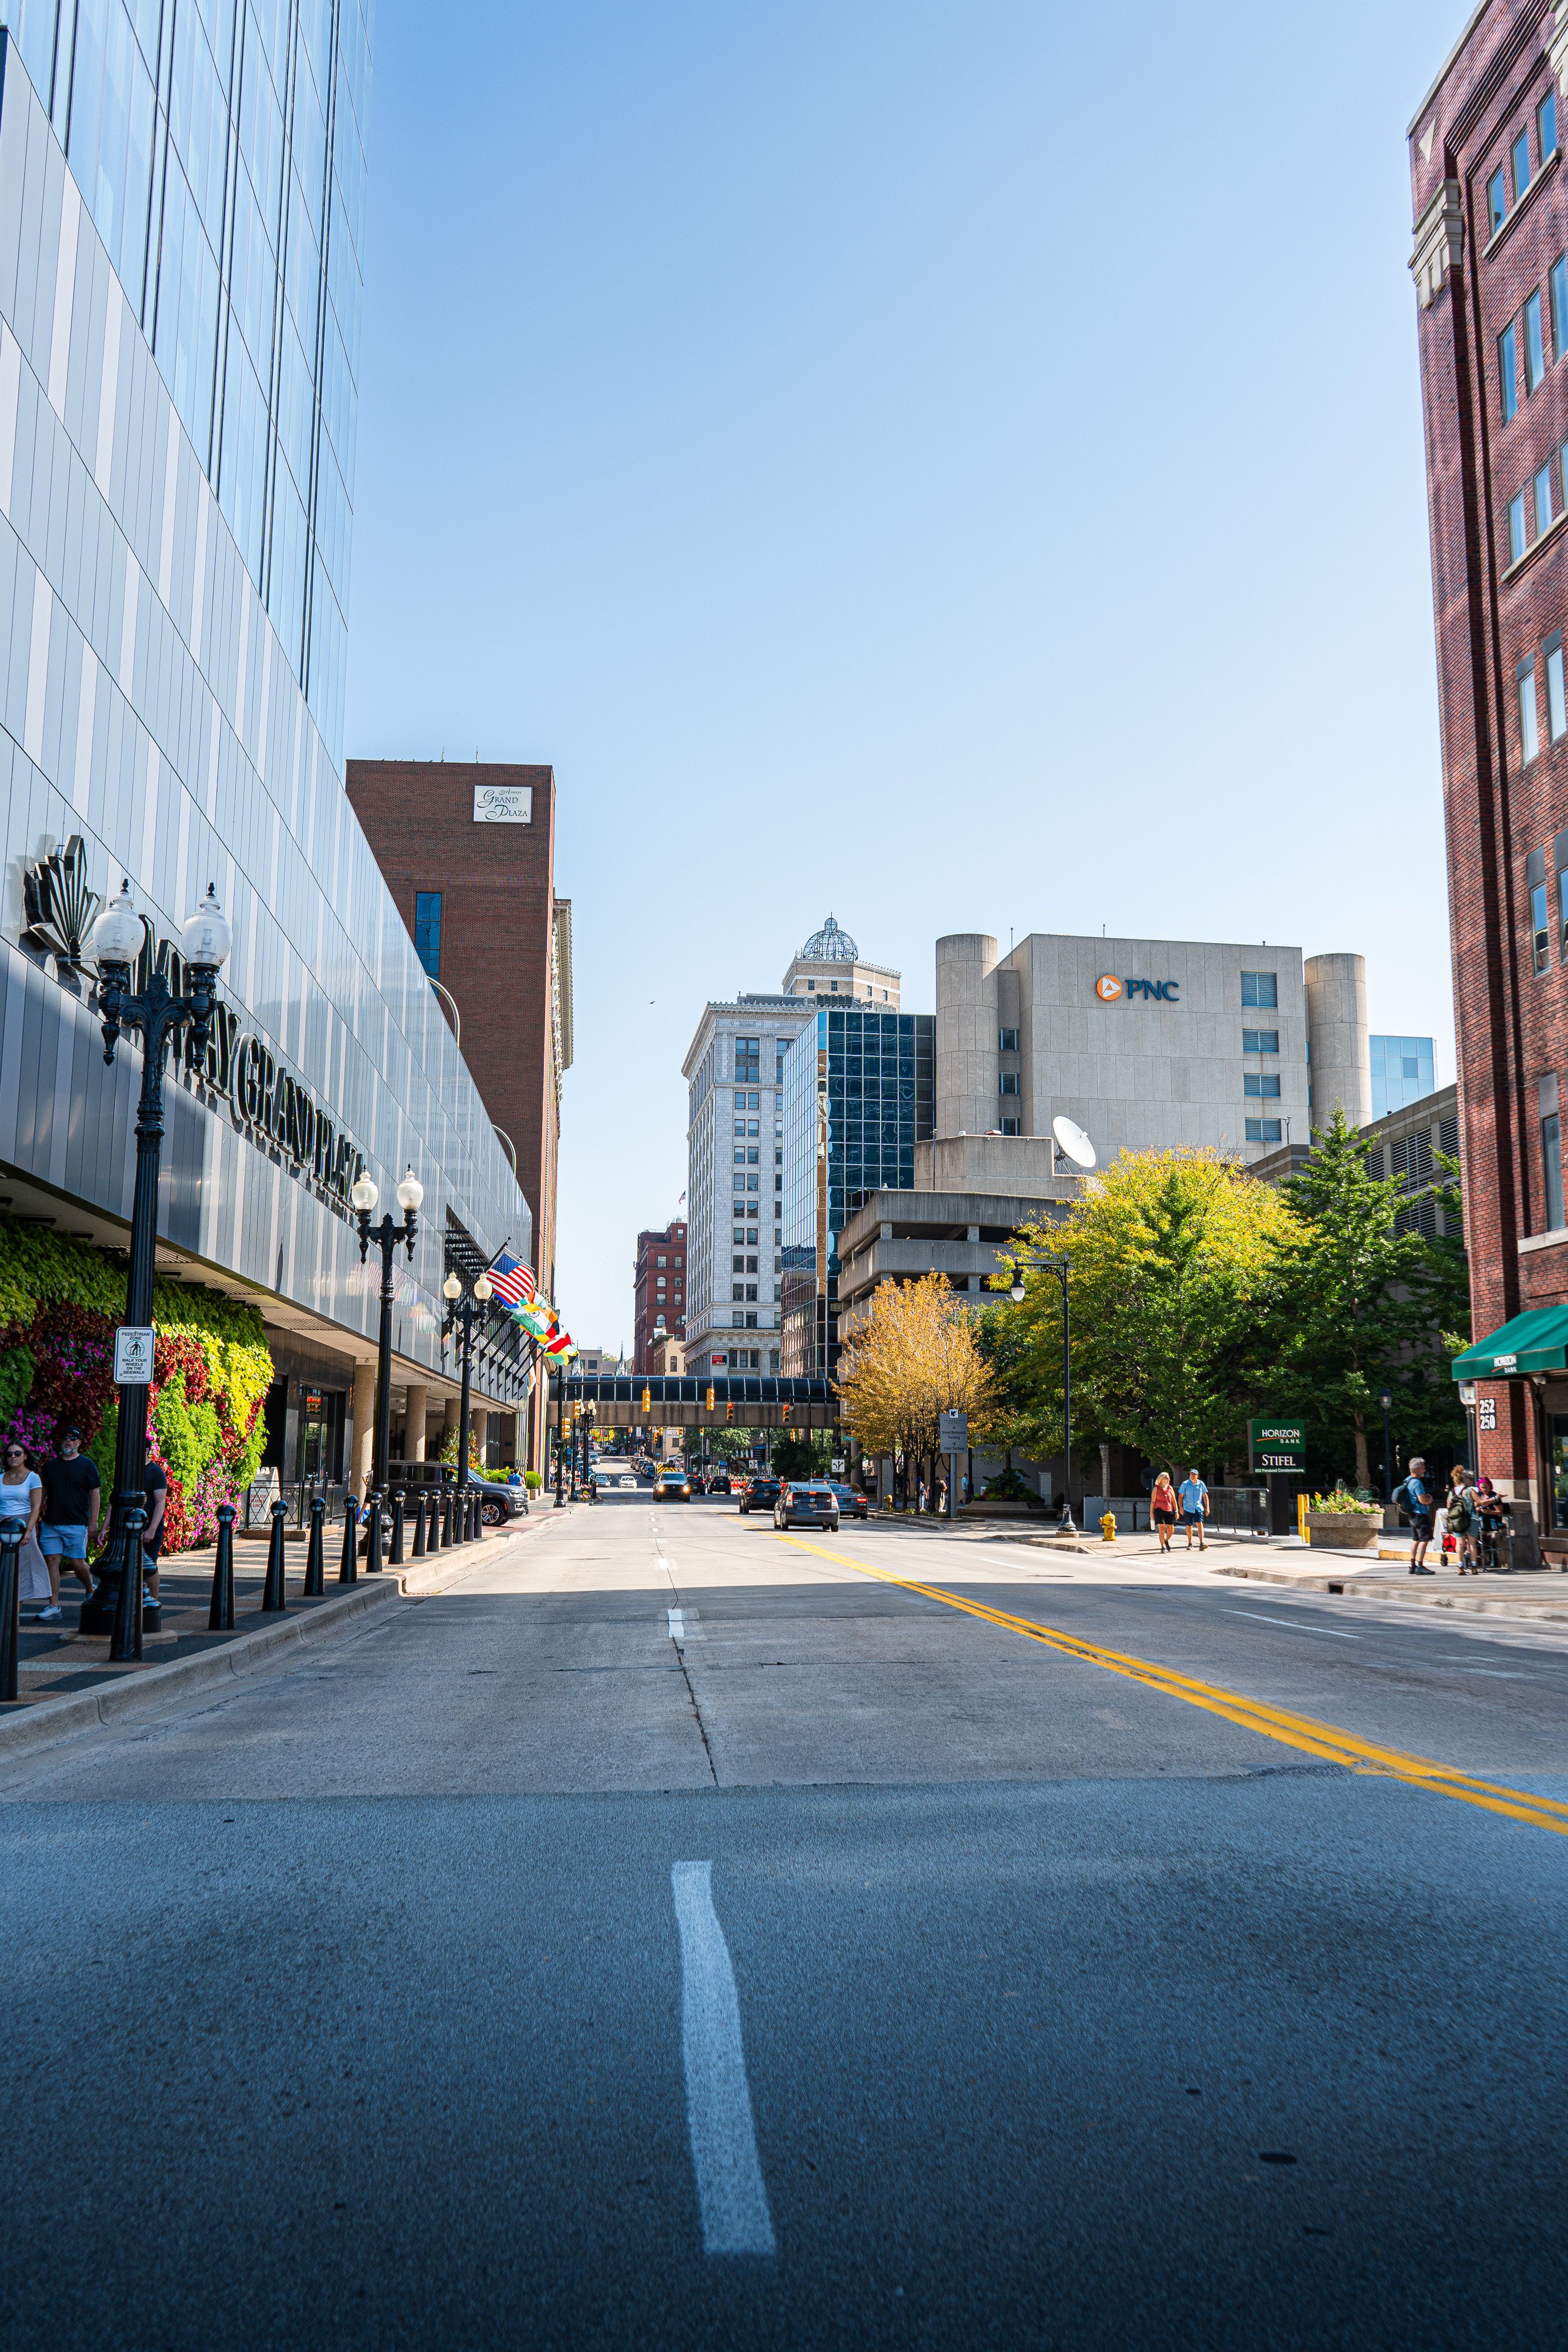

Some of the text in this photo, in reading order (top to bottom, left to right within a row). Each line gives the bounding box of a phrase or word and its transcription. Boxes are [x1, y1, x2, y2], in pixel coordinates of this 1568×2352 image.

[476, 790, 519, 808] GRAND
[485, 804, 528, 820] PLAZA
[1125, 978, 1179, 1002] PNC
[237, 1033, 316, 1169] GRAND
[1494, 1355, 1517, 1367] HORIZON
[1479, 1399, 1495, 1414] 252
[1480, 1415, 1496, 1429] 250
[1262, 1454, 1296, 1466] STIFEL
